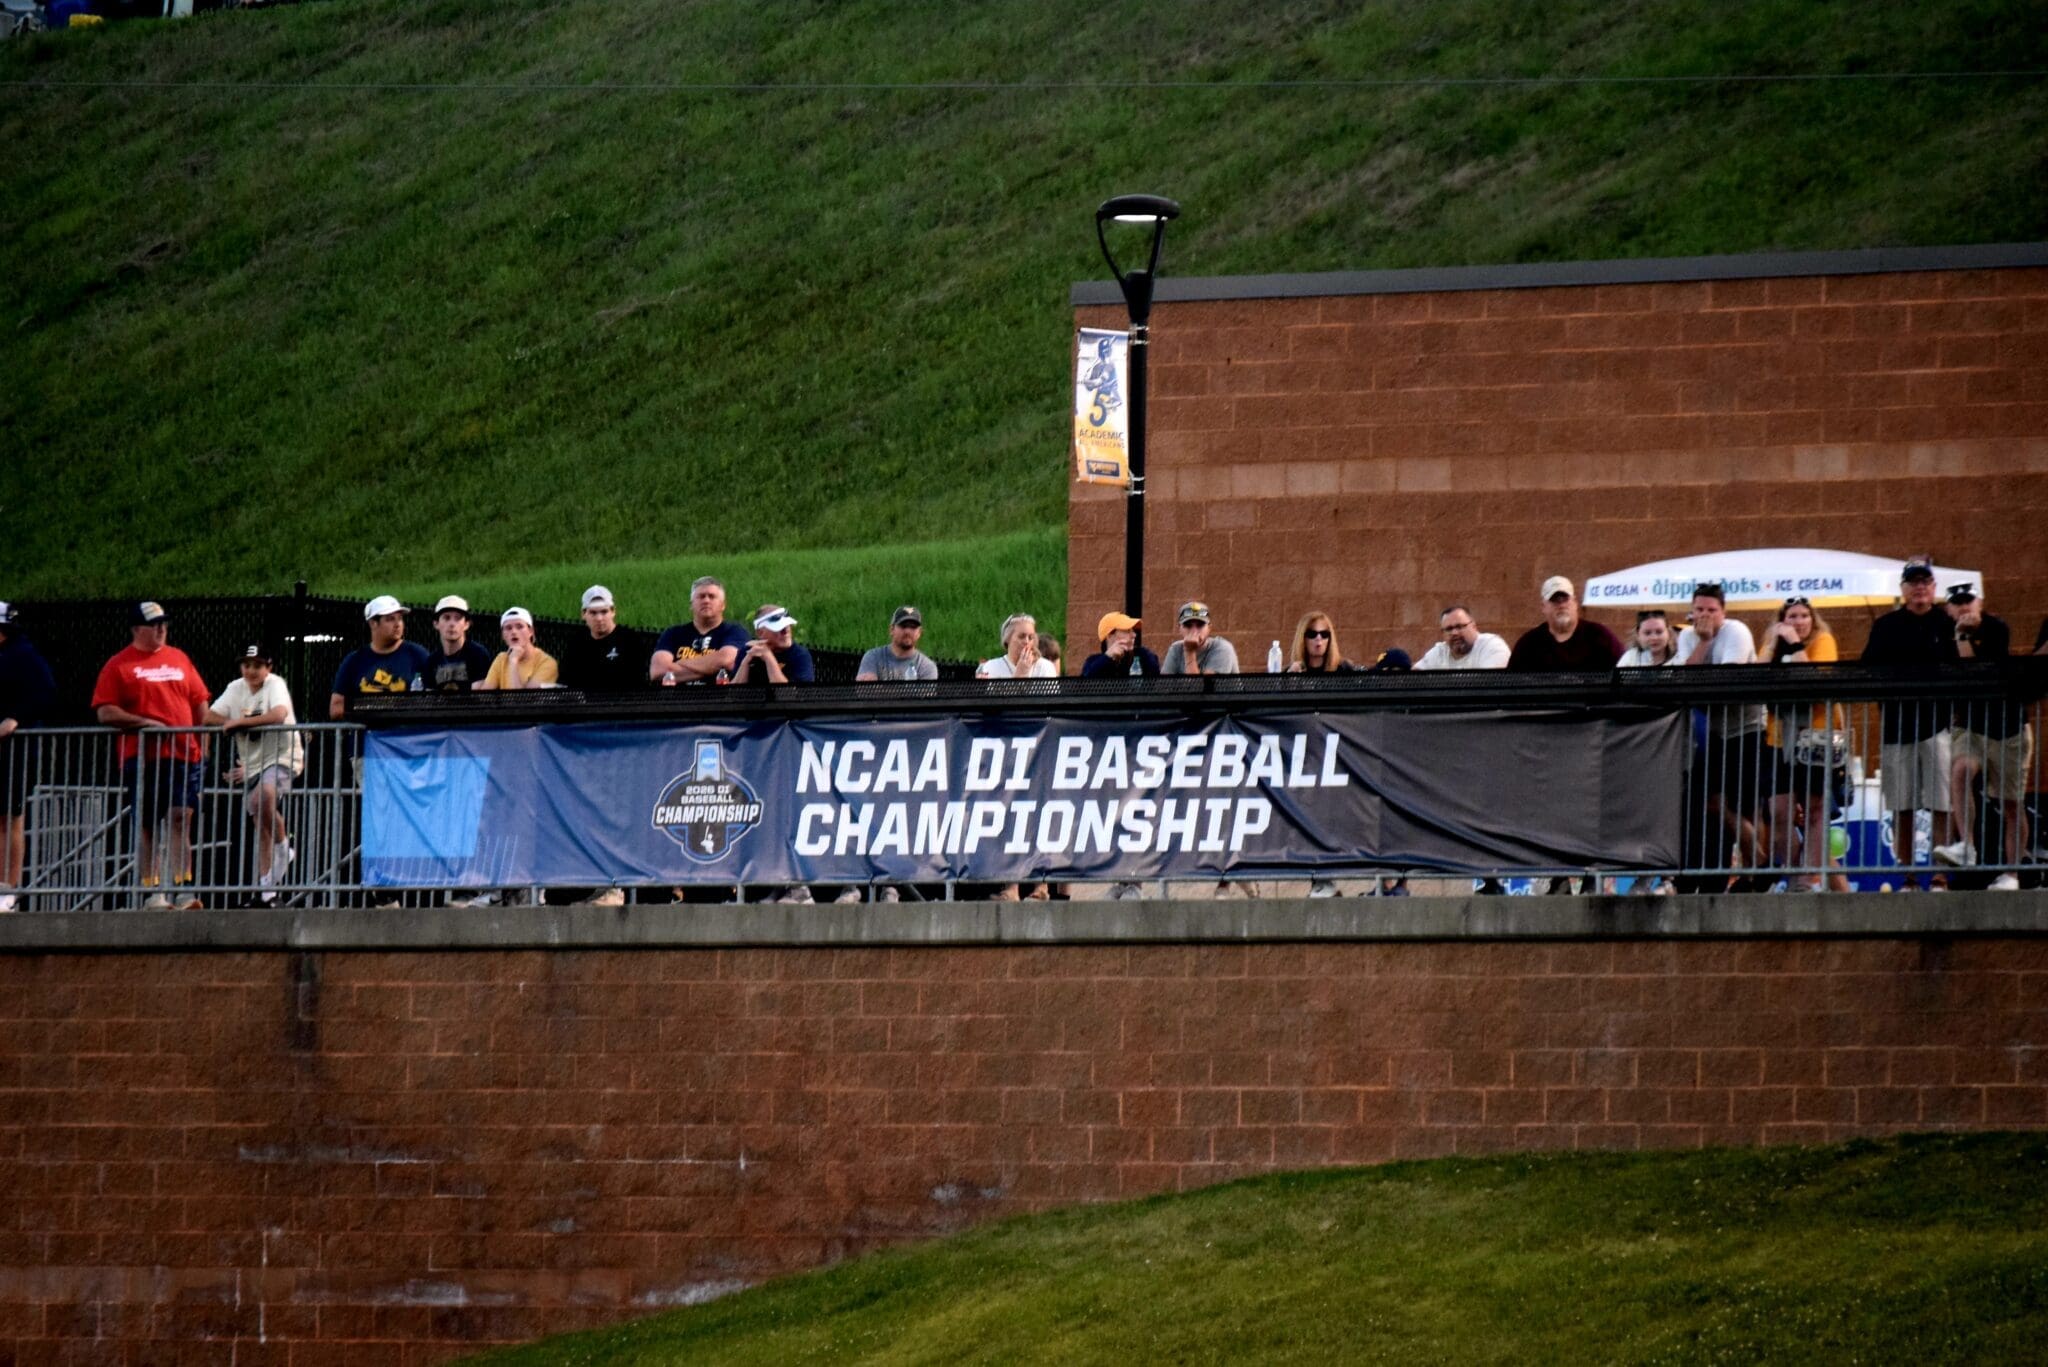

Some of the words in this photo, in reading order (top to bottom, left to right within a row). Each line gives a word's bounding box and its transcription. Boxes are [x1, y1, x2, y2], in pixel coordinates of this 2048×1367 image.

[1079, 429, 1124, 440] ACADEMIC
[1604, 584, 1639, 597] CREAM
[1775, 579, 1793, 592] ICE
[1798, 579, 1843, 591] CREAM
[795, 739, 949, 793] NCAA
[966, 737, 1038, 790] DI
[1052, 734, 1349, 789] BASEBALL
[718, 785, 730, 794] DI
[681, 795, 734, 804] BASEBALL
[656, 805, 760, 823] CHAMPIONSHIP
[794, 798, 1272, 856] CHAMPIONSHIP
